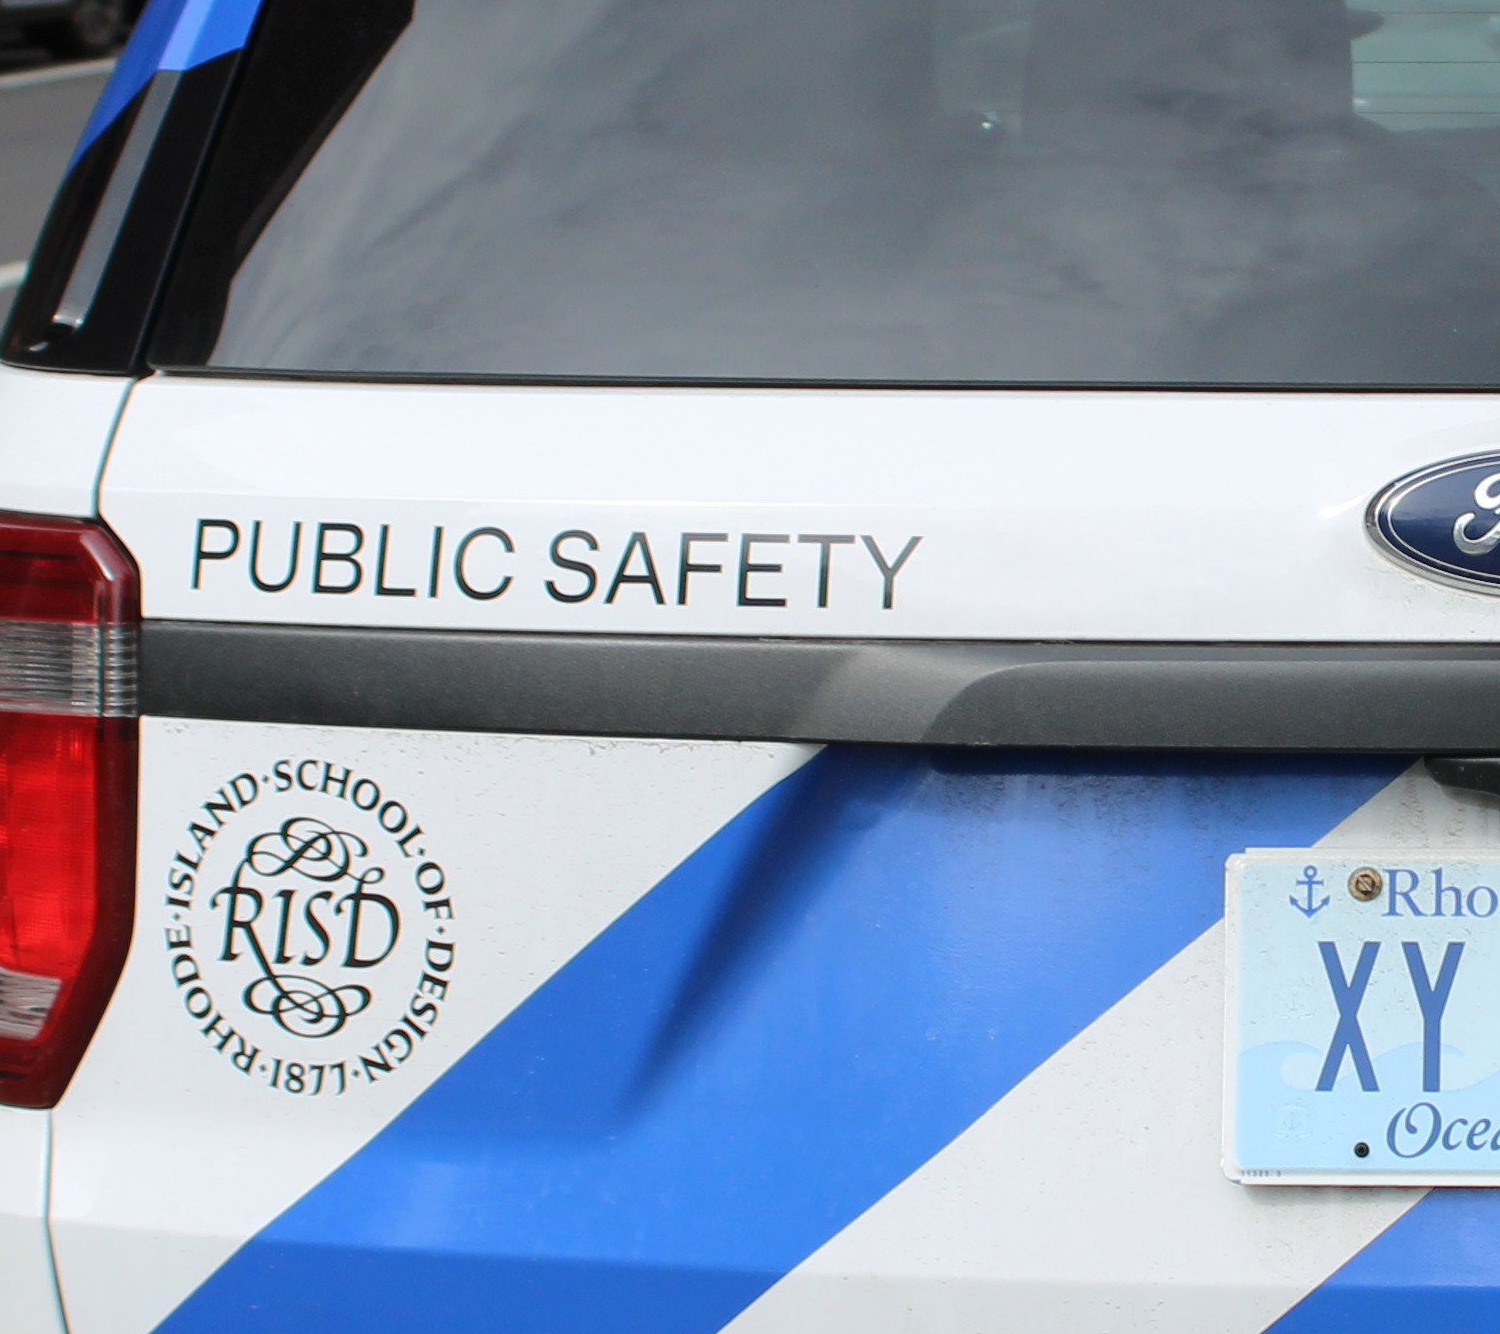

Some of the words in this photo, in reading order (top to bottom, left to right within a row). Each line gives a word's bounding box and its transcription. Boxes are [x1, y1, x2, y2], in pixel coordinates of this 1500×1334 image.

[190, 518, 516, 600] PUBLIC
[543, 530, 924, 610] SAFETY
[164, 773, 259, 910] ISLAND
[271, 759, 425, 858] SCHOOL
[414, 861, 455, 921] OF
[164, 924, 262, 1076] RHODE
[357, 938, 456, 1083] DESIGN
[1314, 941, 1467, 1093] XY
[268, 1057, 347, 1096] 1877
